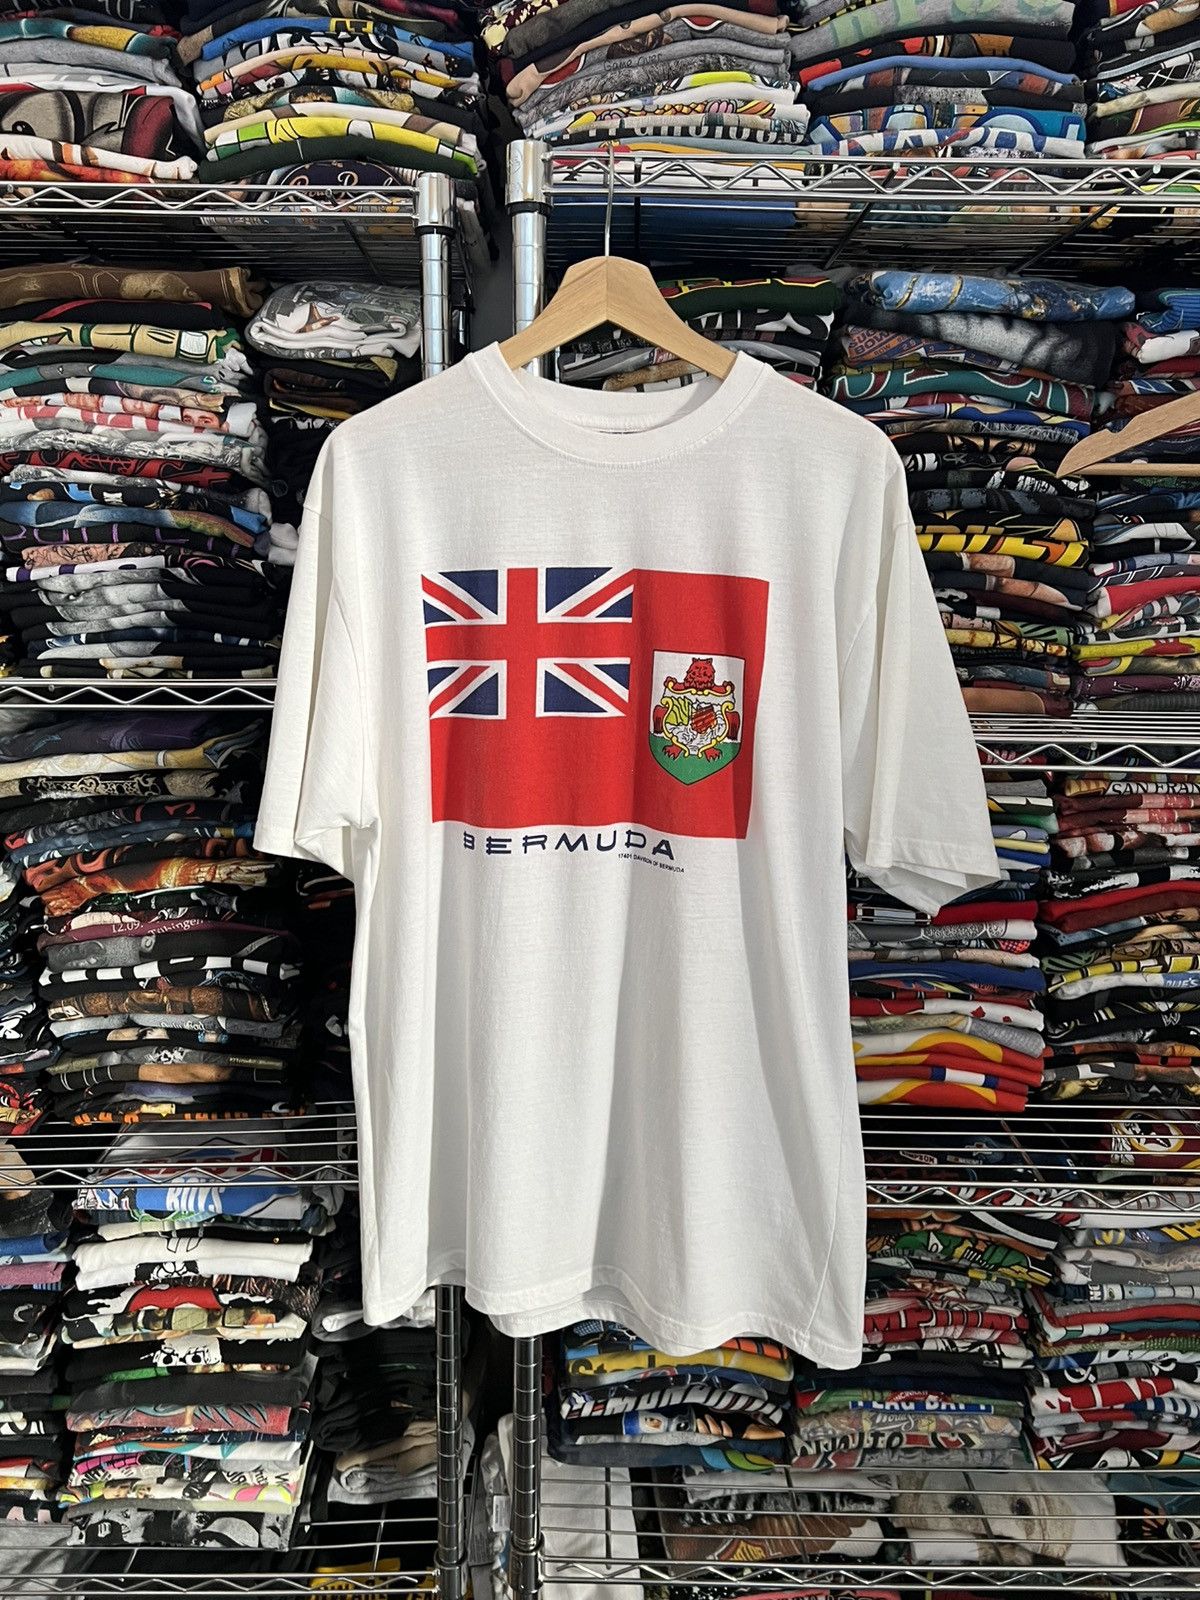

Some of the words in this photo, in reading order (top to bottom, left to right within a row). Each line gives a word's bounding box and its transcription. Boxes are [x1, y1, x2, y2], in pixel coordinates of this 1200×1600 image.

[604, 59, 632, 71] Game
[1112, 782, 1148, 795] SAN
[463, 829, 674, 860] BERMUDA
[659, 862, 685, 873] BERMUDA
